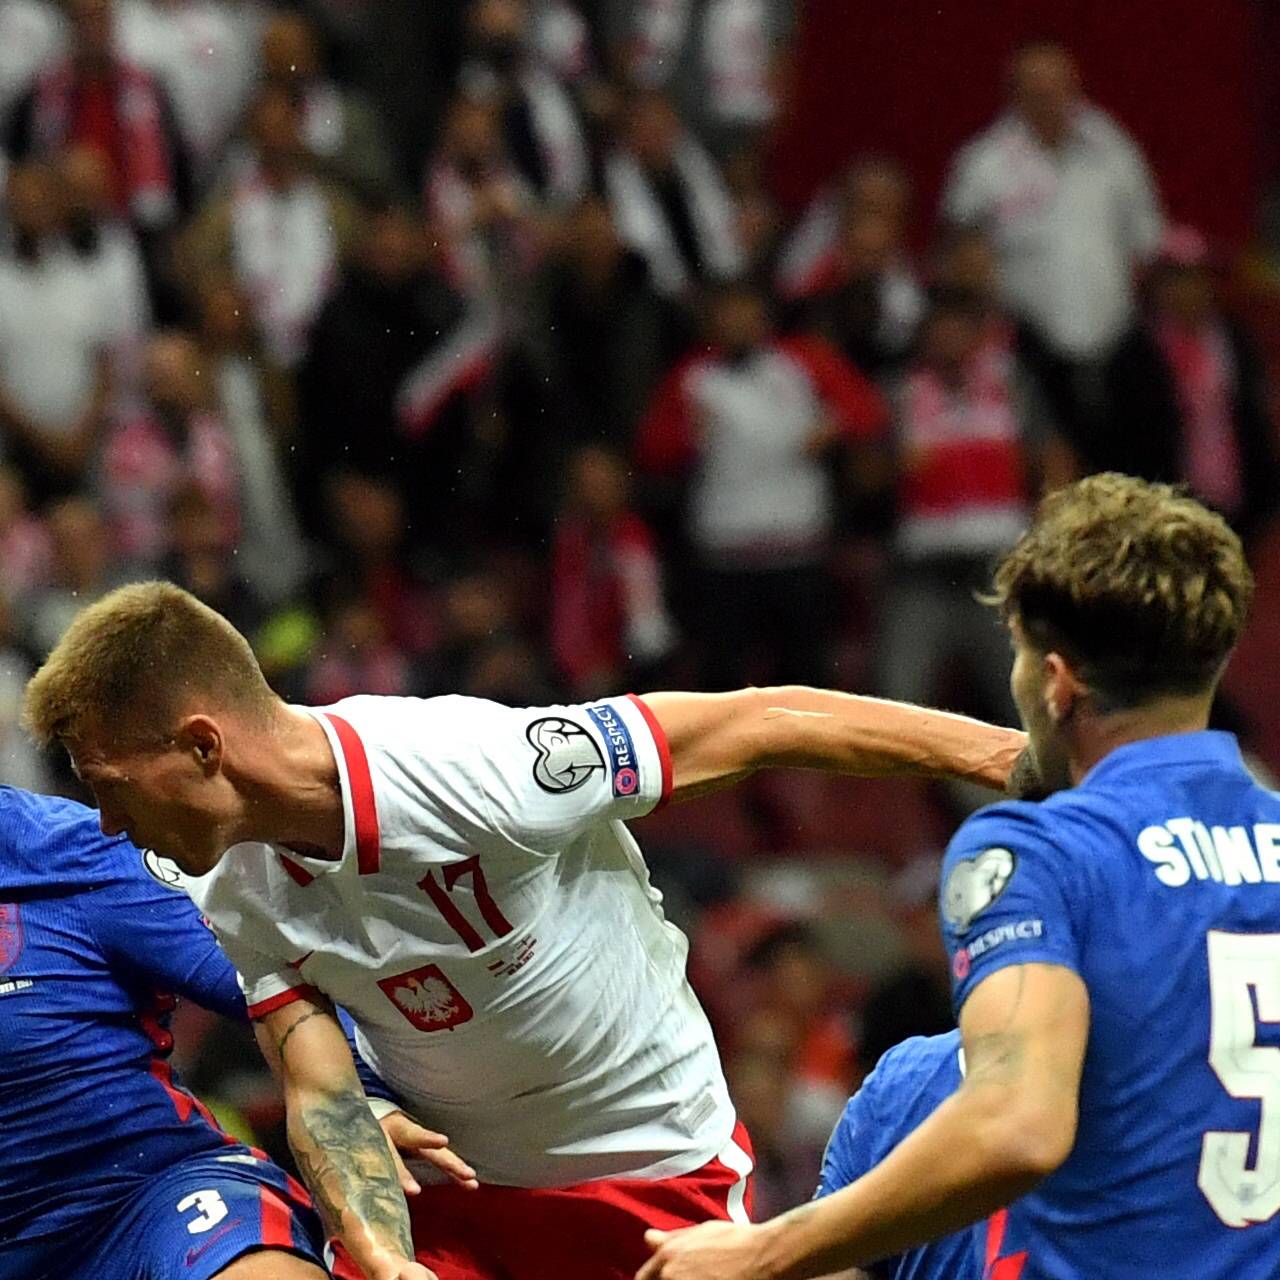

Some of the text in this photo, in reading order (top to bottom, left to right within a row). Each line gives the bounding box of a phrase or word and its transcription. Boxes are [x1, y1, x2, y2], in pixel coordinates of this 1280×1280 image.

[591, 706, 631, 767] RESPECT
[416, 853, 514, 954] 17
[1197, 928, 1280, 1228] 5
[176, 1189, 229, 1234] 3
